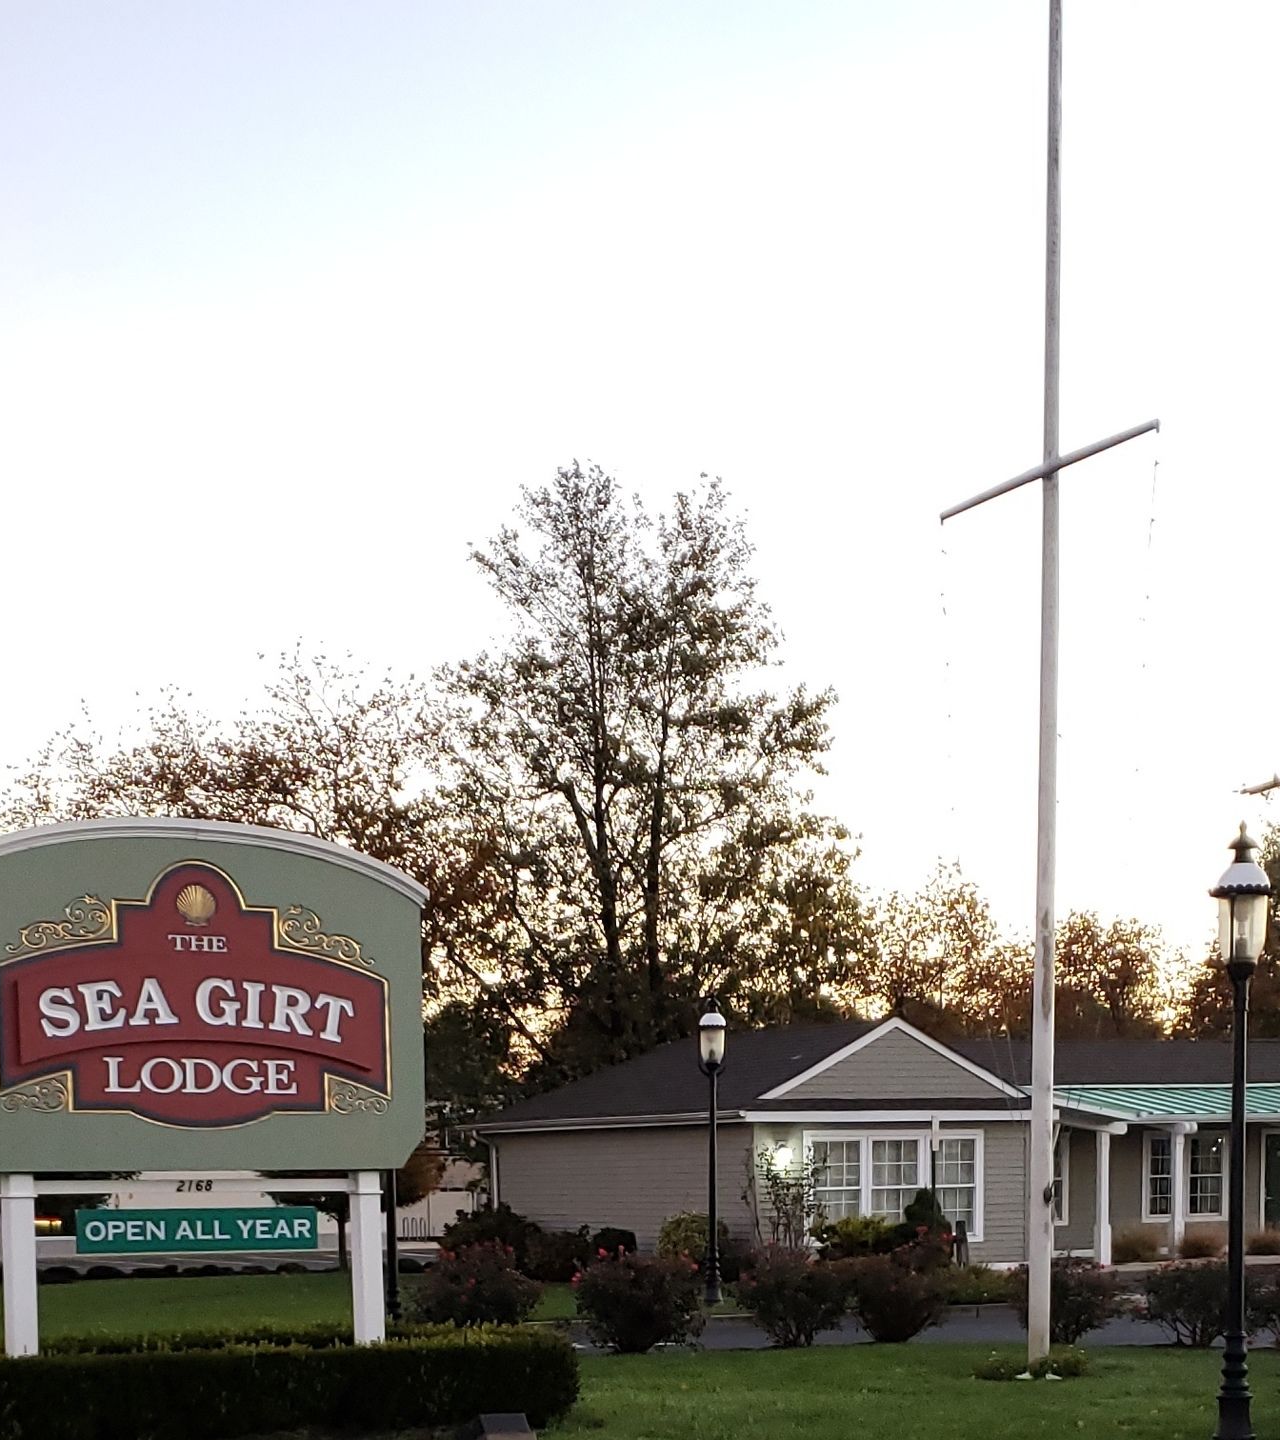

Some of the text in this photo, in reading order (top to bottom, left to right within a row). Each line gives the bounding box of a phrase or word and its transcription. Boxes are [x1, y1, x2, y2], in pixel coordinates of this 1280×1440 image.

[167, 934, 228, 953] THE
[38, 977, 355, 1043] SEA GIRT
[102, 1056, 298, 1095] LODGE
[176, 1179, 214, 1193] 2168
[84, 1218, 312, 1242] OPEN ALL YEAR
